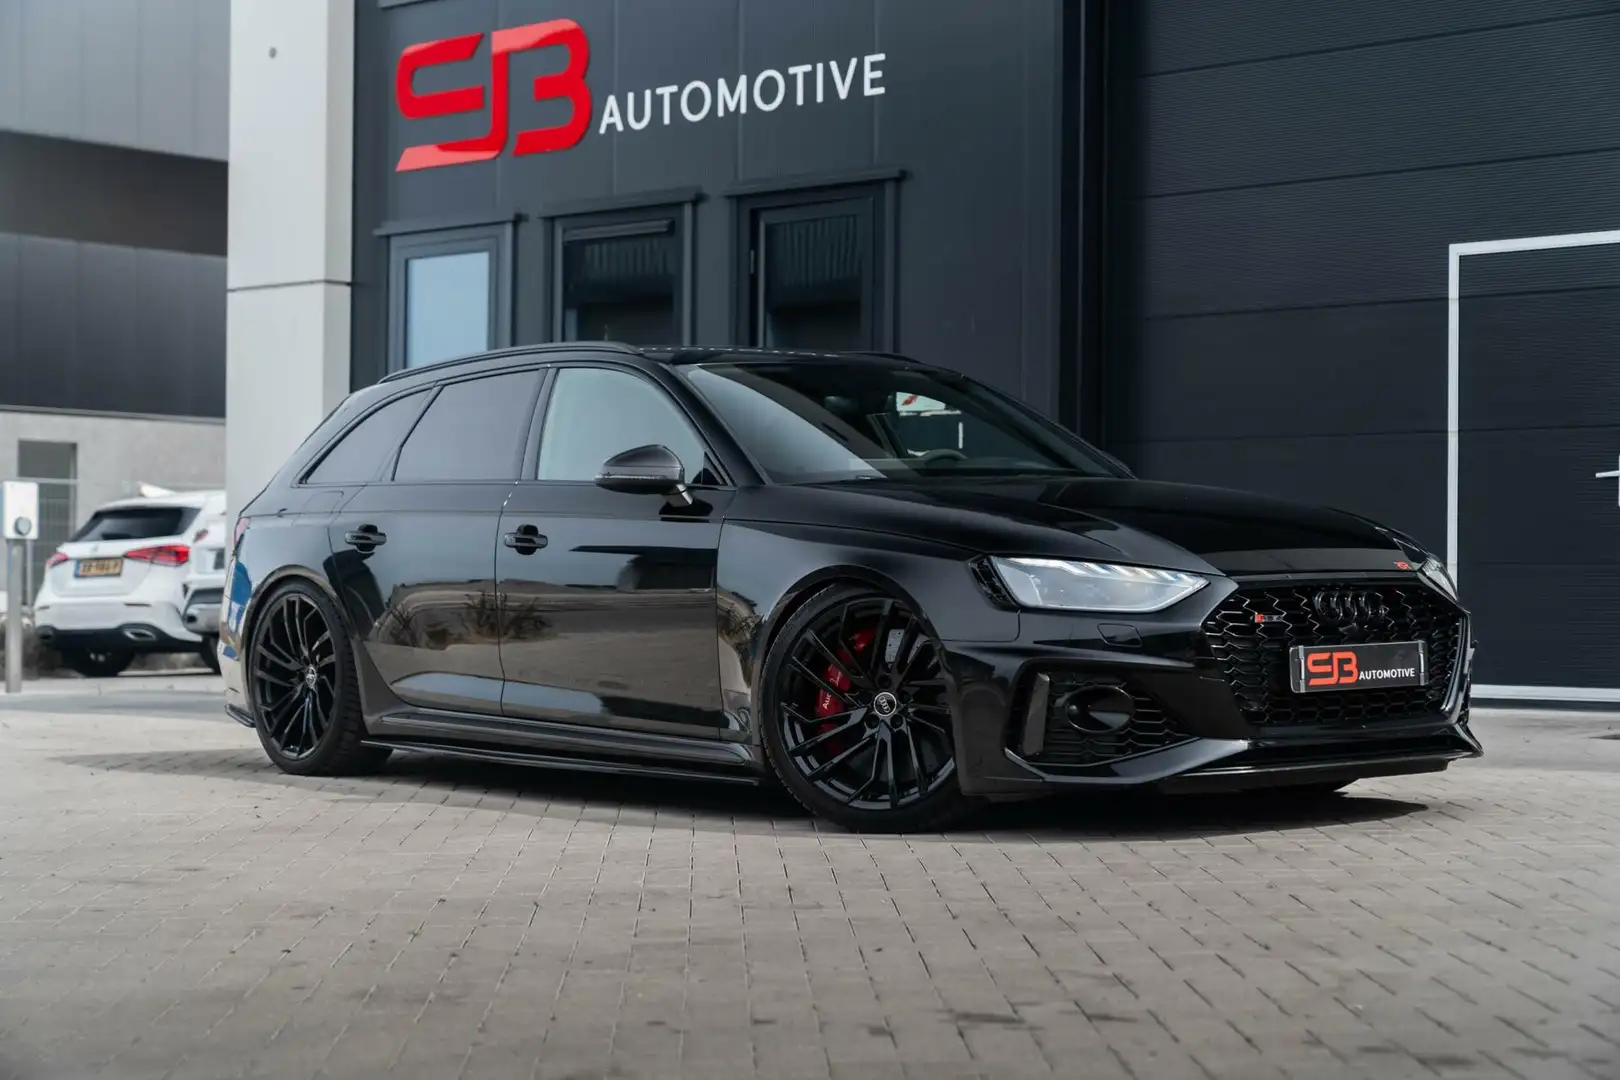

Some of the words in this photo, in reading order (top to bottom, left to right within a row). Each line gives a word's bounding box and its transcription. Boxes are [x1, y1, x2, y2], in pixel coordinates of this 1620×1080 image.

[395, 19, 592, 171] SB
[599, 53, 886, 134] AUTOMOTIVE
[1307, 651, 1358, 686] SB
[1358, 668, 1416, 681] AUTOMOTIVE
